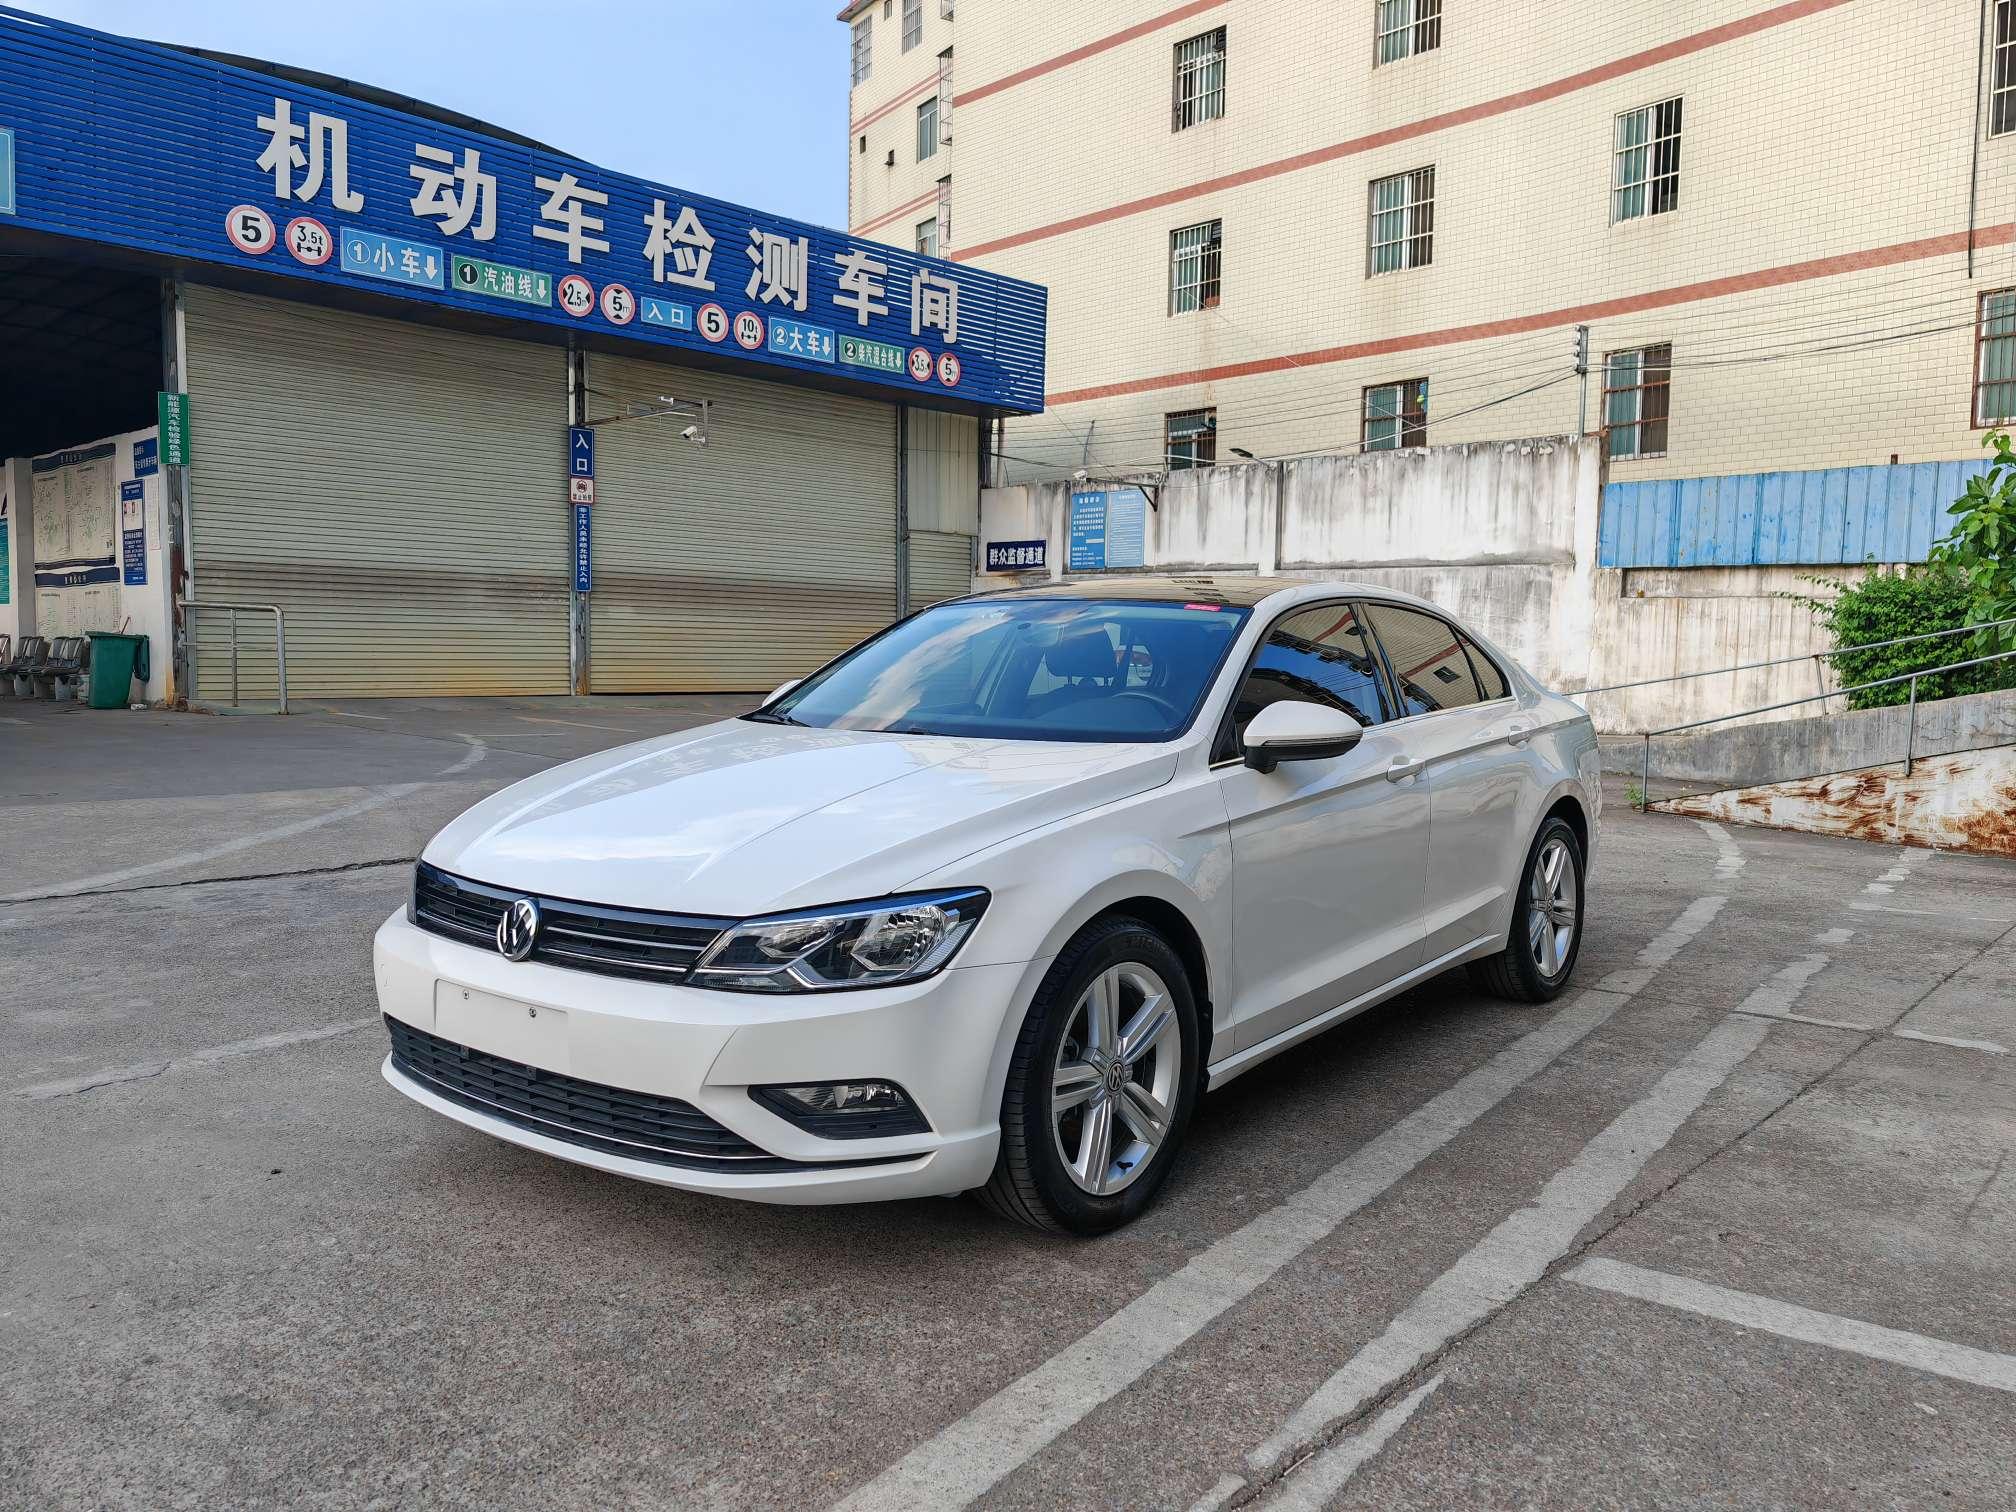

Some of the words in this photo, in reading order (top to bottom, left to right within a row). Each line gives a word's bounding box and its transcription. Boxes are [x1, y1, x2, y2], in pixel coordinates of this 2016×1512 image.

[241, 214, 262, 243] 5
[256, 97, 959, 345] 机动车检测车间
[648, 303, 684, 325] 入口
[707, 312, 720, 333] 5
[576, 433, 589, 472] 入口
[989, 546, 1044, 566] 群众监督通道
